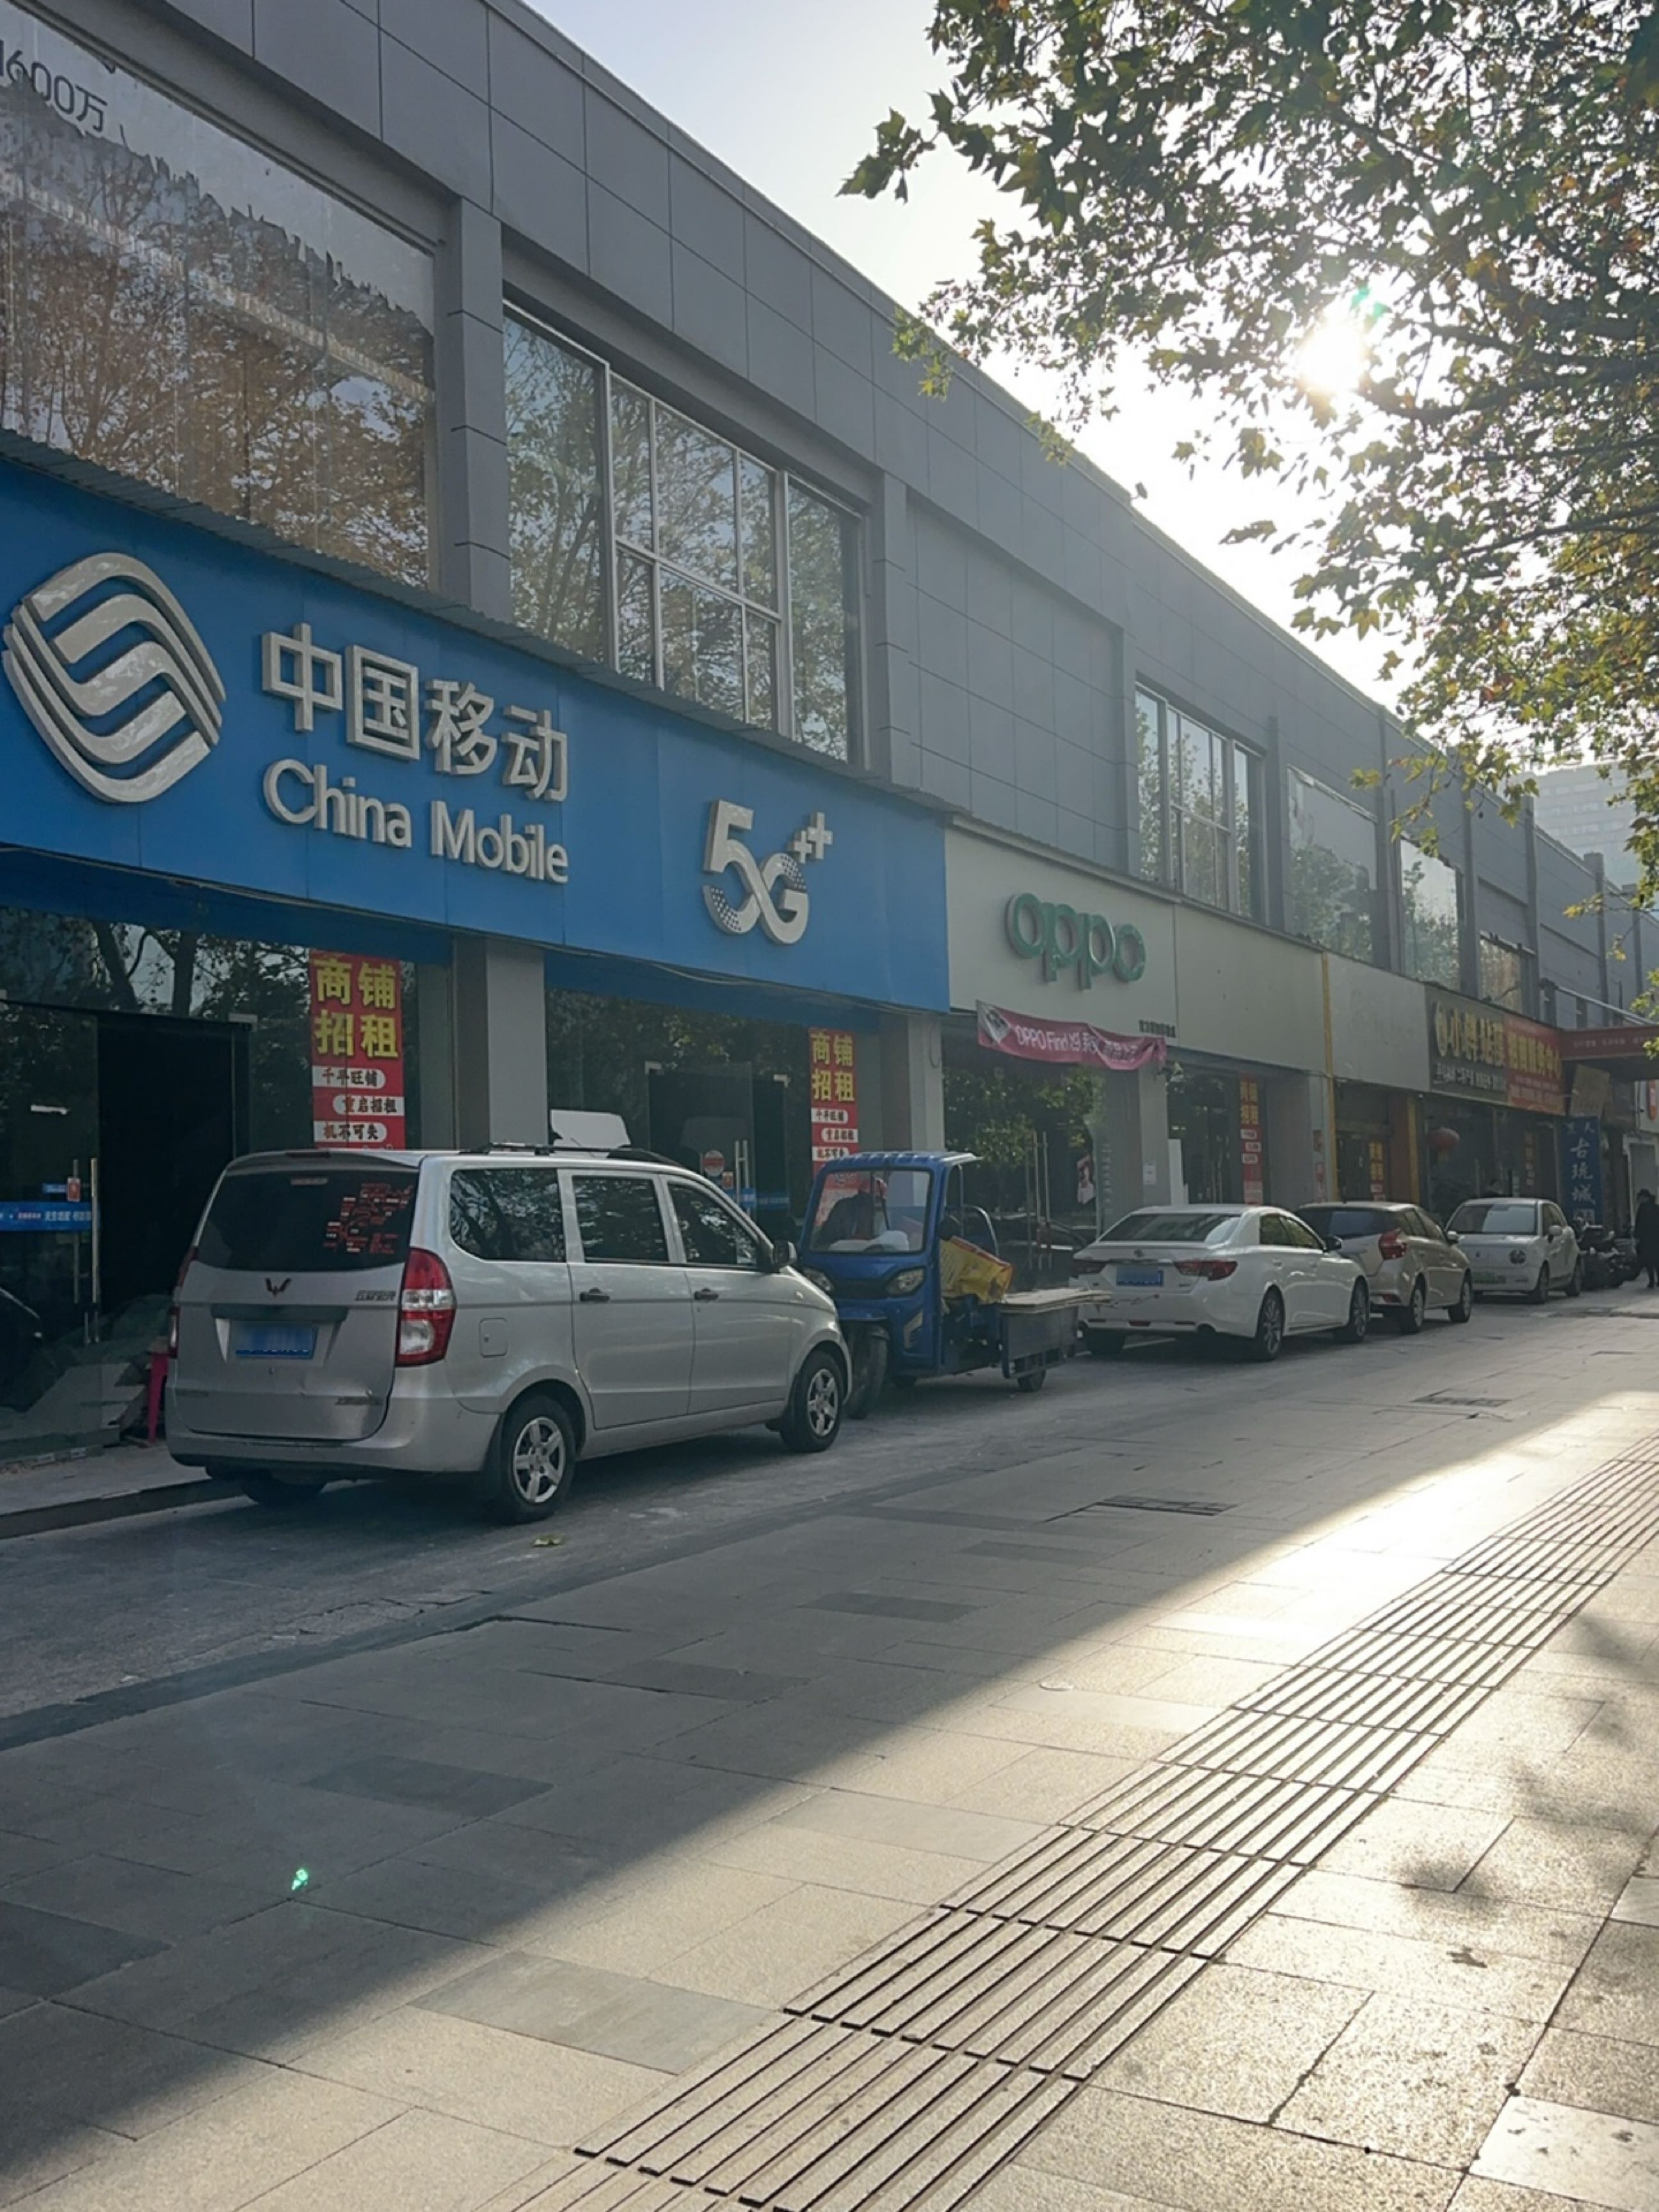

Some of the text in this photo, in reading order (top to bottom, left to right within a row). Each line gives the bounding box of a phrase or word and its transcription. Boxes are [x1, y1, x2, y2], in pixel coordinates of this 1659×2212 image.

[262, 623, 568, 803] 中国移动
[263, 758, 569, 884] China Mobile
[314, 958, 396, 1009] 商铺
[314, 1009, 399, 1058] 招租
[810, 1031, 853, 1066] 商铺
[811, 1068, 855, 1102] 招租
